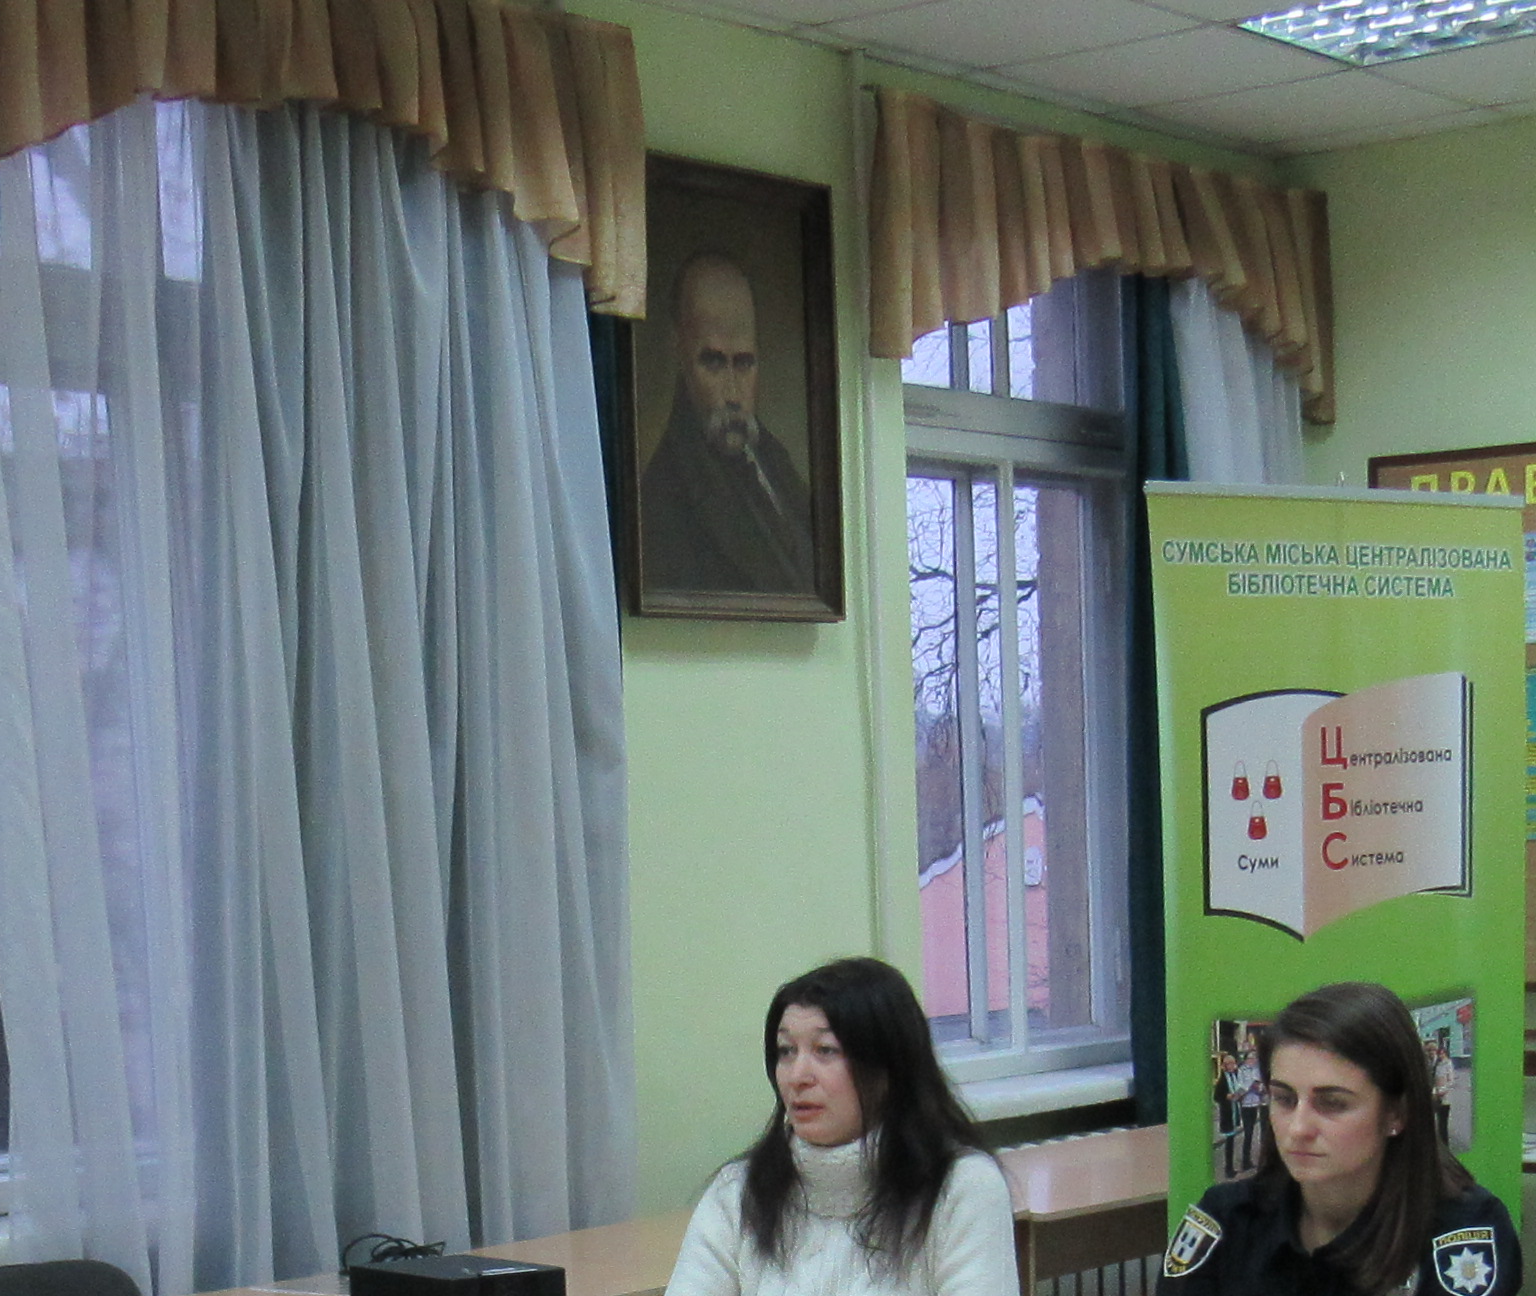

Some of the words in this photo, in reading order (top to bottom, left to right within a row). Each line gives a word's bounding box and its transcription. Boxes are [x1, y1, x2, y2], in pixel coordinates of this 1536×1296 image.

[1162, 540, 1258, 564] СУМСЬКА
[1265, 543, 1339, 566] МІСЬКА
[1346, 544, 1511, 570] ЦЕНТРАЛІЗОВАНА
[1228, 572, 1359, 596] БІБЛІОТЕЧНА
[1364, 576, 1454, 597] СИСТЕМА
[1320, 726, 1452, 769] Централізована
[1321, 782, 1424, 820] Бібліотечна
[1238, 855, 1279, 873] Суми
[1321, 832, 1404, 870] Система
